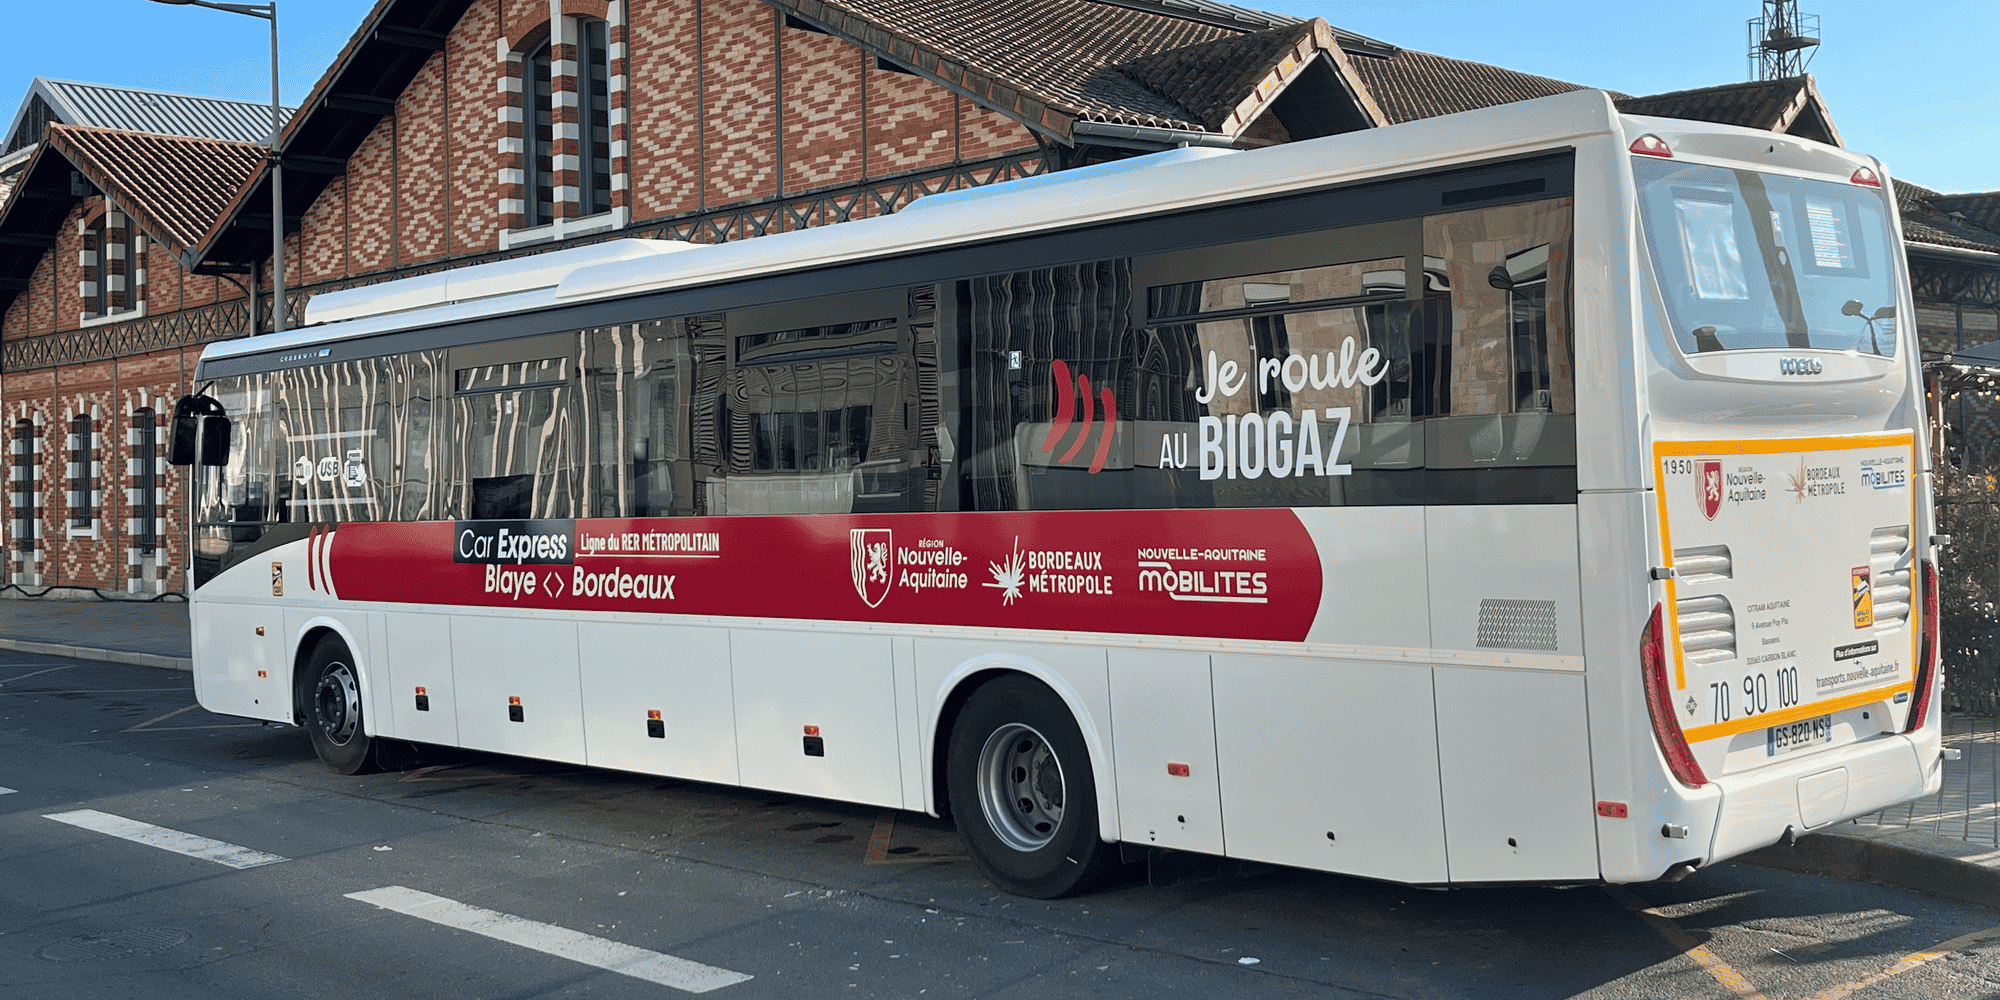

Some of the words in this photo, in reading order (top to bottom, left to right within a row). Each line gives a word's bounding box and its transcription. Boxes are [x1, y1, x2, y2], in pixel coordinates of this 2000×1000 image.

[1195, 350, 1247, 404] Je
[1259, 336, 1390, 395] roule
[1159, 433, 1188, 469] AU
[1199, 407, 1352, 480] BIOGAZ
[320, 461, 339, 477] USB
[1664, 460, 1692, 474] 1950
[1726, 472, 1766, 486] Nouvelle-
[1807, 467, 1840, 481] BORDEAUX
[1727, 487, 1766, 506] Aquitaine
[1808, 481, 1845, 497] MÉTROPOLE
[459, 529, 494, 558] Car
[497, 529, 567, 565] Express
[580, 533, 605, 554] Ligne
[608, 534, 619, 551] du
[621, 533, 640, 551] RER
[642, 529, 720, 552] MÉTROPOLITAIN
[918, 538, 944, 548] RÉGION
[897, 547, 968, 566] Nouvelle-
[1028, 551, 1102, 570] BORDEAUX
[1137, 548, 1267, 561] NOUVELLE-AQUITAINE
[485, 564, 536, 600] Blaye
[572, 566, 675, 600] Bordeaux
[898, 568, 968, 593] Aquitaine
[1029, 569, 1113, 594] MÉTROPOLE
[1743, 673, 1768, 716] 90
[1776, 665, 1799, 708] 100
[1710, 681, 1730, 723] 70
[1776, 718, 1825, 748] GS-820-NS
